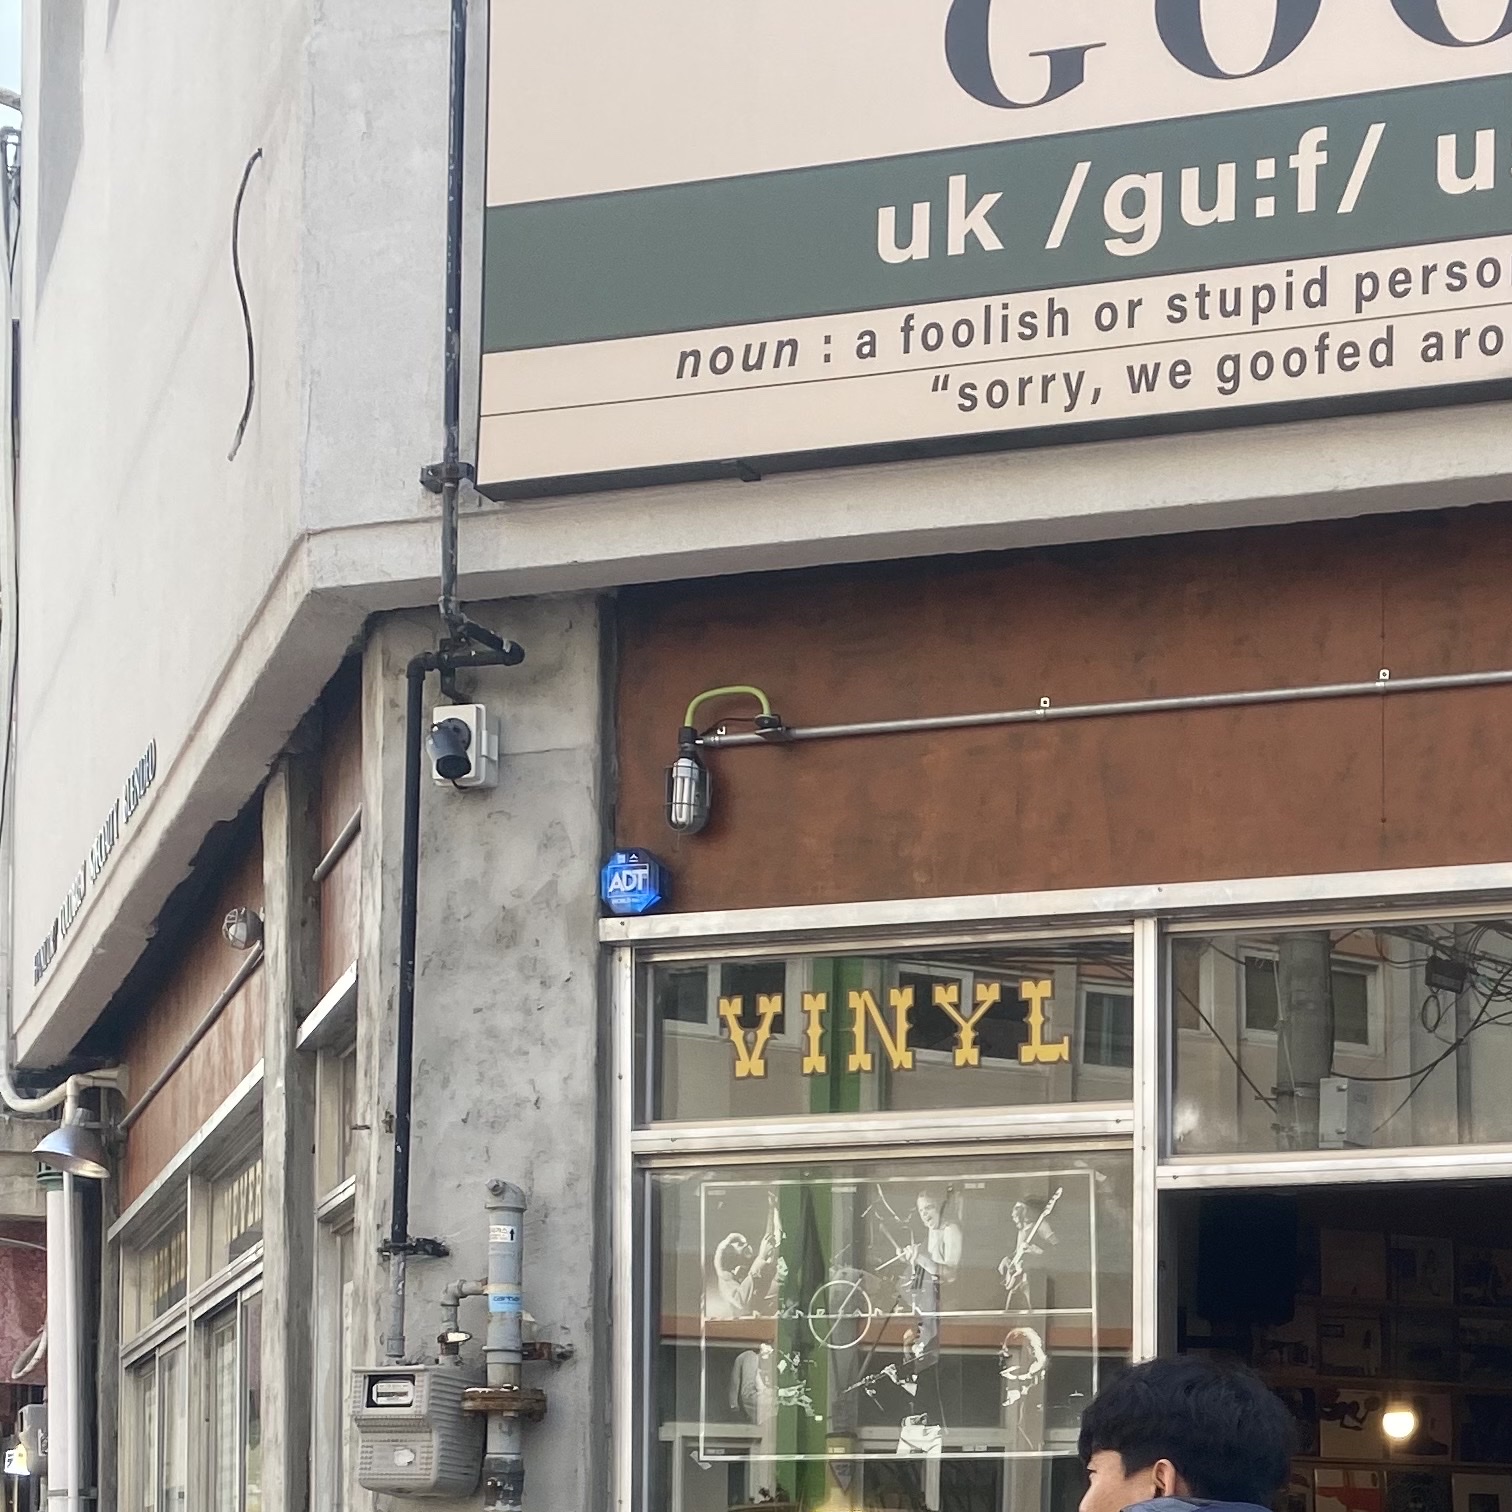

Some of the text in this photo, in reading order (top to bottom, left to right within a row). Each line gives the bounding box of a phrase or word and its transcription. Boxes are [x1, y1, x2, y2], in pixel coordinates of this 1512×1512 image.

[876, 173, 1006, 265] uk
[1044, 121, 1388, 257] /gu:f/
[674, 334, 801, 379] noun
[855, 328, 879, 360] a
[899, 297, 1071, 356] foolish
[1094, 295, 1144, 332] or
[1165, 265, 1330, 324] stupid
[1125, 359, 1193, 395] we
[1215, 312, 1396, 398] goofed
[608, 869, 648, 893] ADT
[717, 978, 1071, 1080] VINYL
